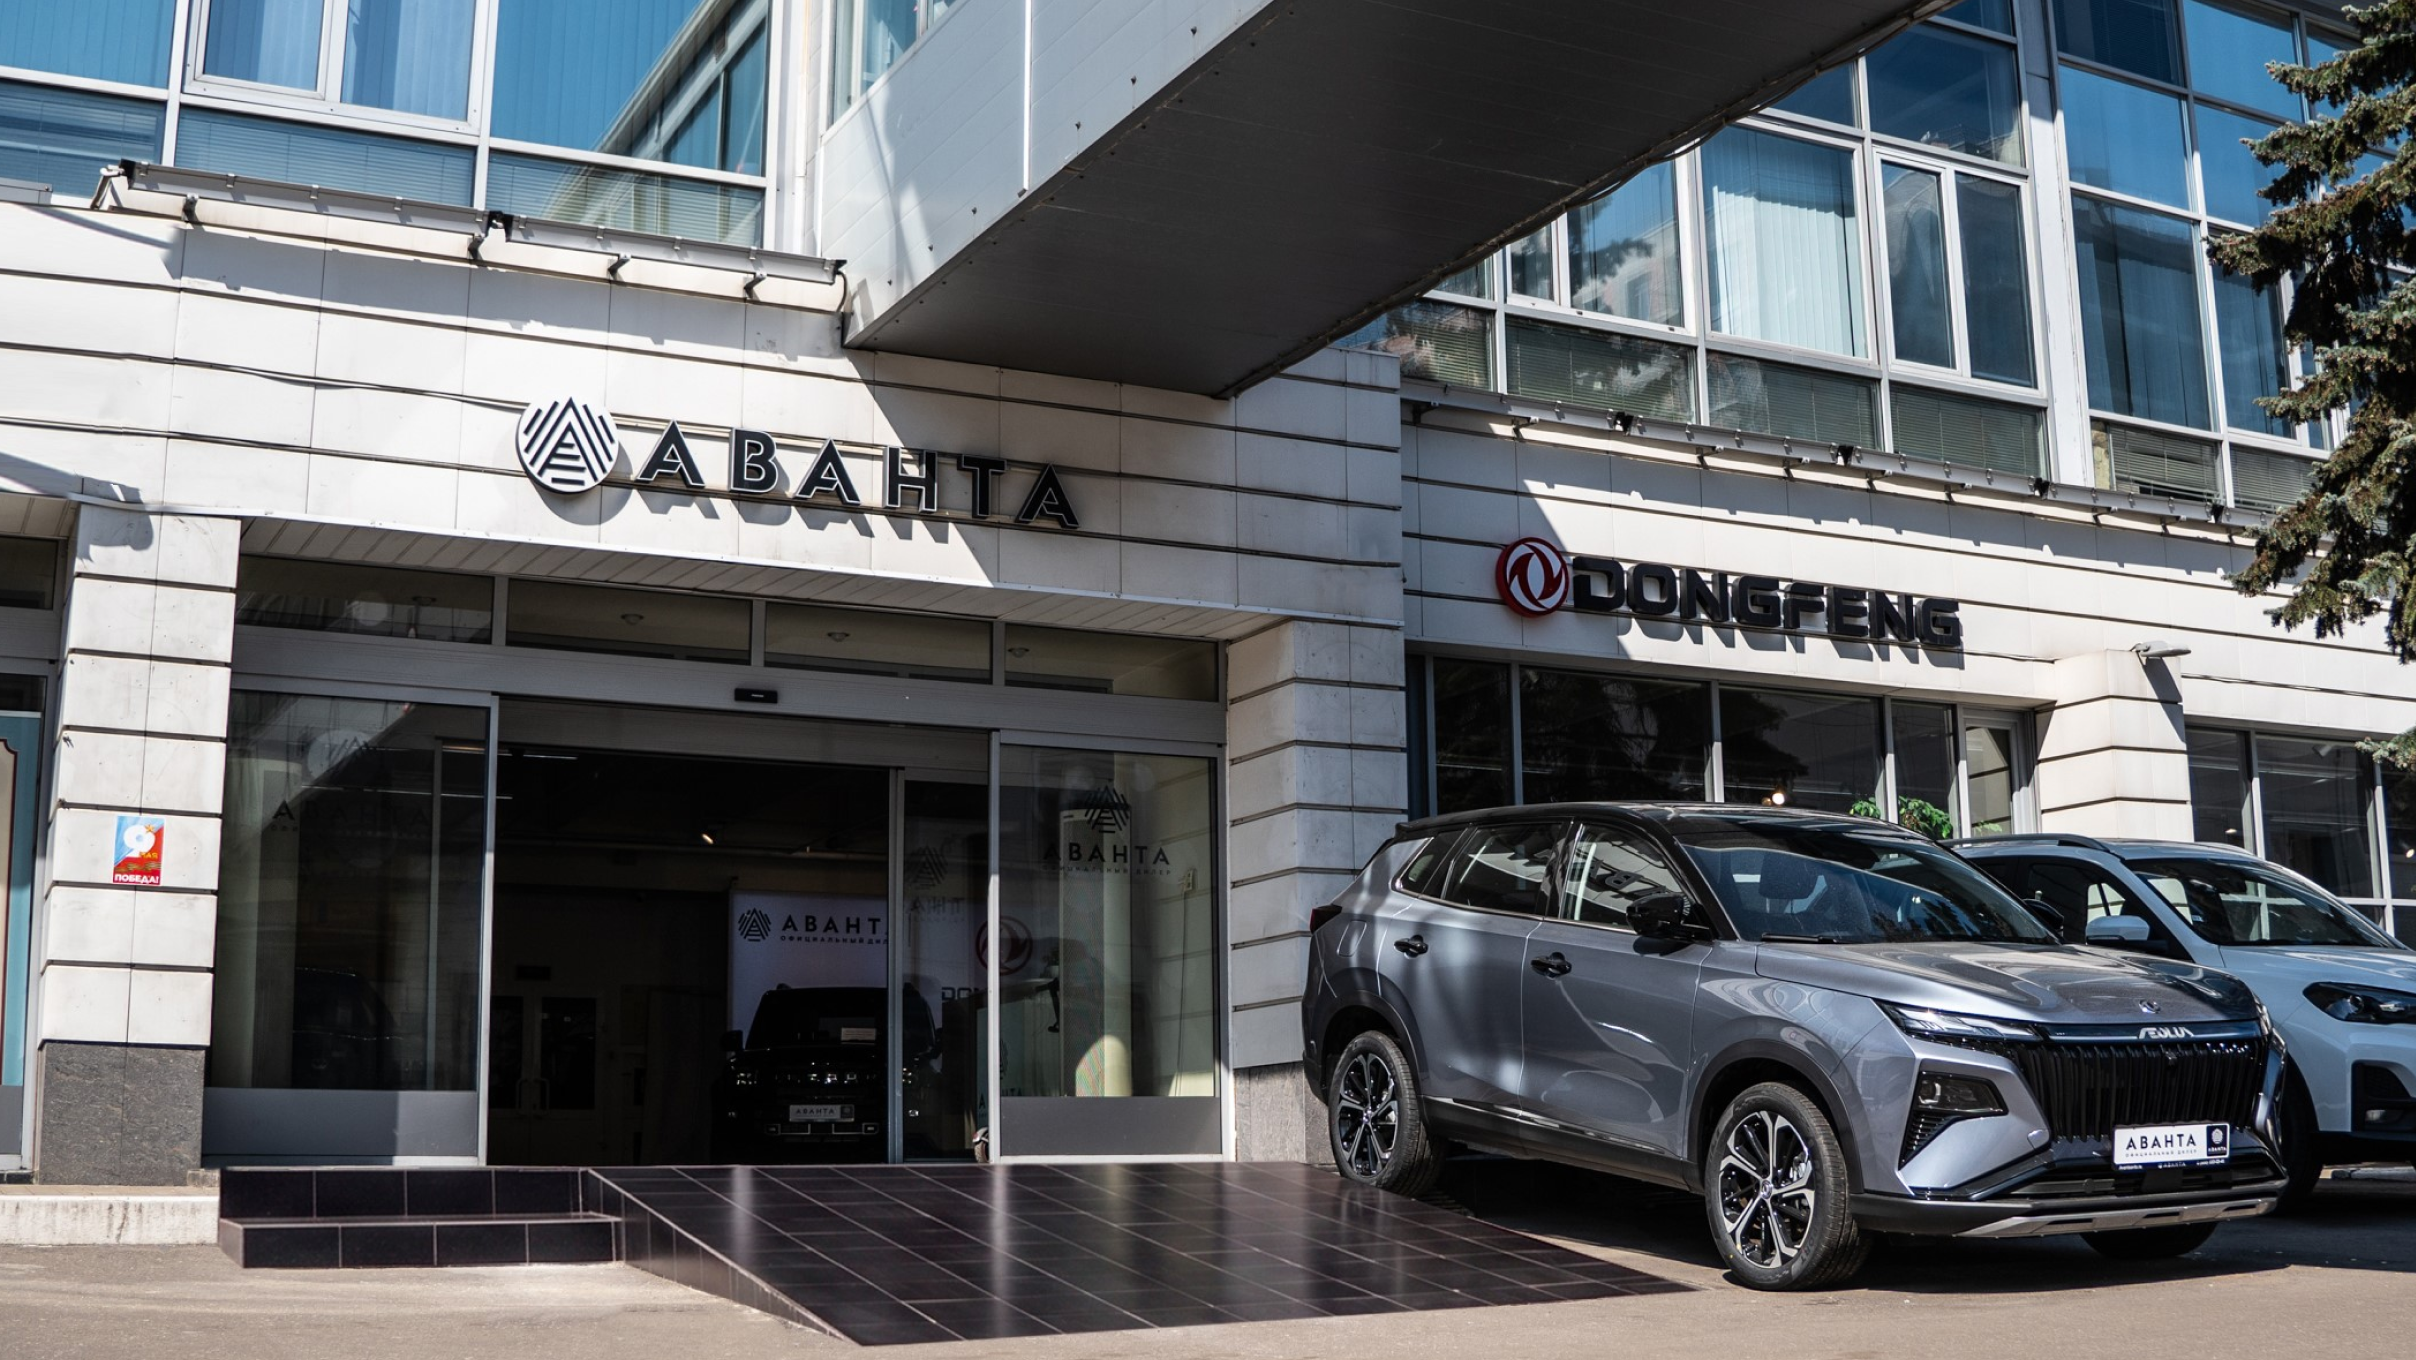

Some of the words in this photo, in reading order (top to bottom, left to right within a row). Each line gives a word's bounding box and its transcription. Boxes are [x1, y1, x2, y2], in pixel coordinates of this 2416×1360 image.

[636, 419, 1080, 529] АВАНТА
[1572, 556, 1962, 648] DONGFENG
[123, 824, 156, 858] 9
[1043, 842, 1170, 865] АВАНТА
[114, 873, 160, 884] ПОБЕДА!
[1136, 868, 1171, 876] ДИЛЕР
[781, 914, 888, 935] АВАНТ
[780, 935, 864, 944] ОФИЦИАЛЬНЫЙ
[2126, 1134, 2196, 1150] АВАНТА
